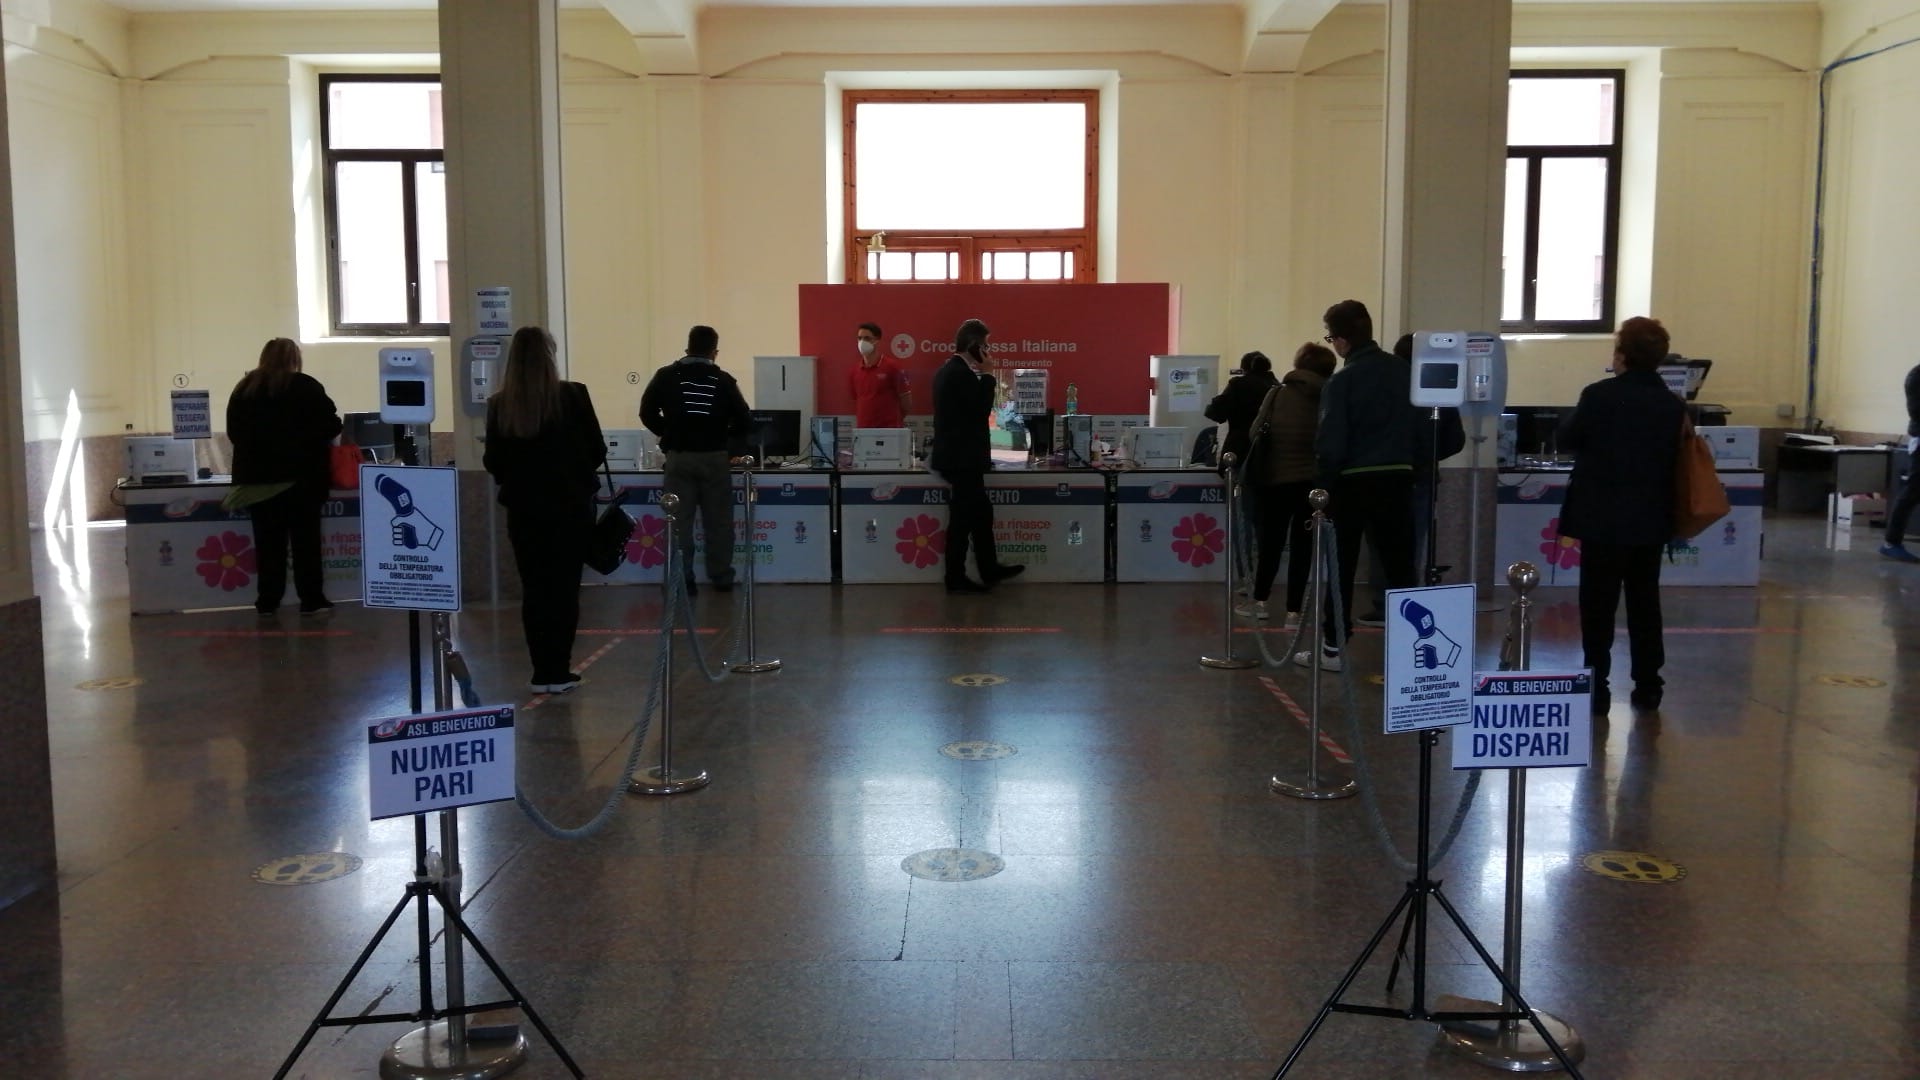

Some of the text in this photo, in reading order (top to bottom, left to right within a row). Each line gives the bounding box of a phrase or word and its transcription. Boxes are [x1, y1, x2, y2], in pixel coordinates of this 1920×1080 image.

[920, 340, 957, 353] Croc
[1022, 339, 1077, 353] Italiana
[1002, 358, 1053, 367] Benevento
[648, 490, 662, 503] AS
[923, 490, 946, 503] ASL
[1200, 488, 1224, 502] ASL
[1007, 518, 1051, 529] rinasce
[1014, 530, 1041, 541] fiore
[393, 554, 429, 563] CONTROLLO
[379, 562, 444, 572] DELLA TEMPERATURA
[390, 572, 433, 581] OBBLIGATORIO
[1414, 674, 1447, 684] CONTROLLO
[1401, 681, 1460, 695] DELLA TEMPERATURA
[1490, 680, 1573, 693] ASL BENEVENTO
[1410, 691, 1451, 702] OBBLIGATORIO
[1474, 703, 1570, 729] NUMERI
[407, 715, 496, 737] ASL BENEVENTO
[1472, 732, 1570, 758] DISPARI
[391, 738, 495, 775] NUMERI
[415, 770, 473, 802] PARI
